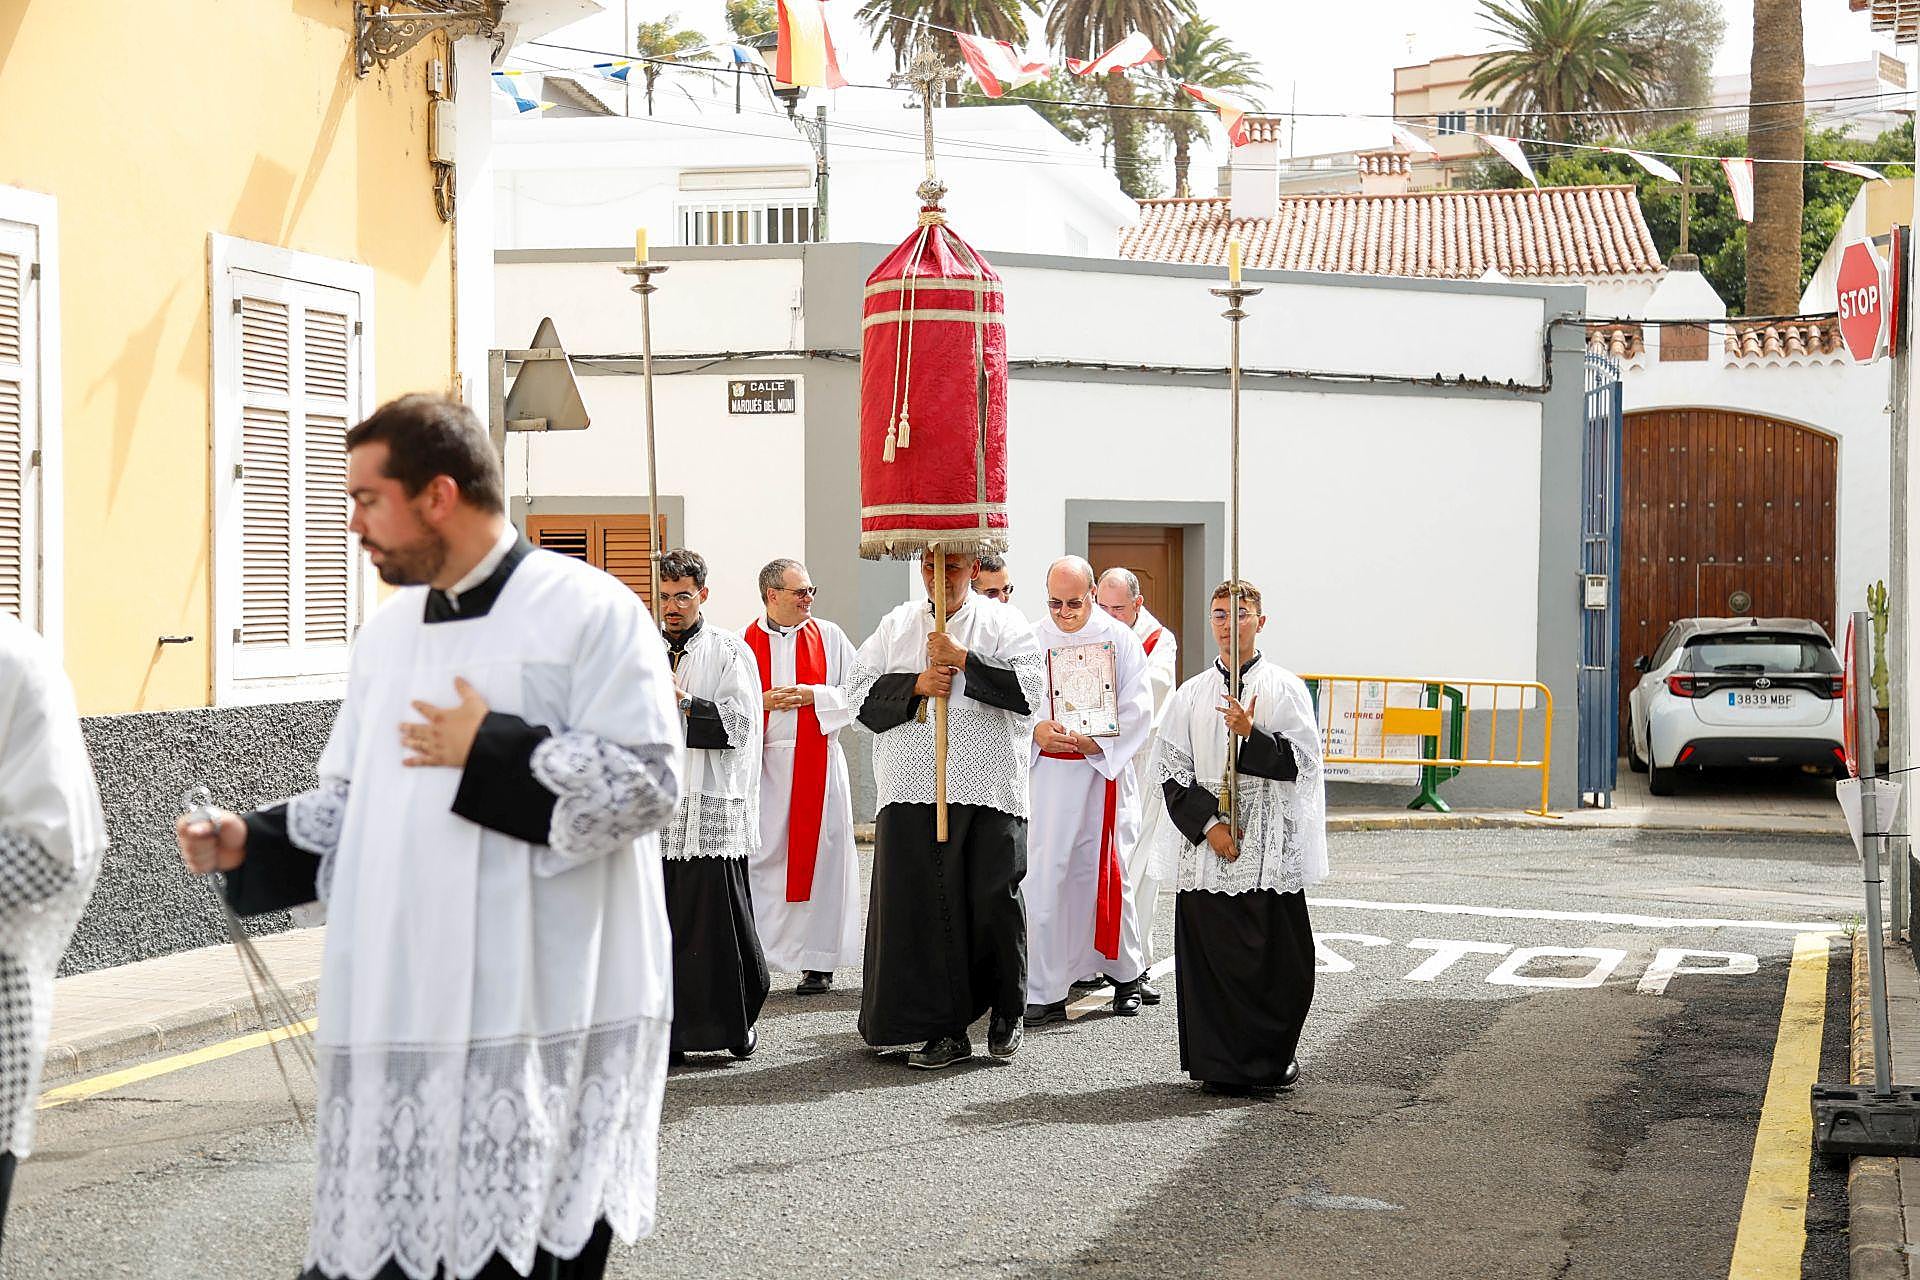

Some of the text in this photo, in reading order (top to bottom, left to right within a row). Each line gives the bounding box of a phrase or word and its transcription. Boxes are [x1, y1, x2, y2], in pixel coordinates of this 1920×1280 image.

[1840, 285, 1878, 319] STOP
[750, 382, 784, 391] CALLE
[763, 400, 776, 412] DEL
[1737, 694, 1793, 705] 3839 MBF
[1314, 932, 1760, 995] STOP
